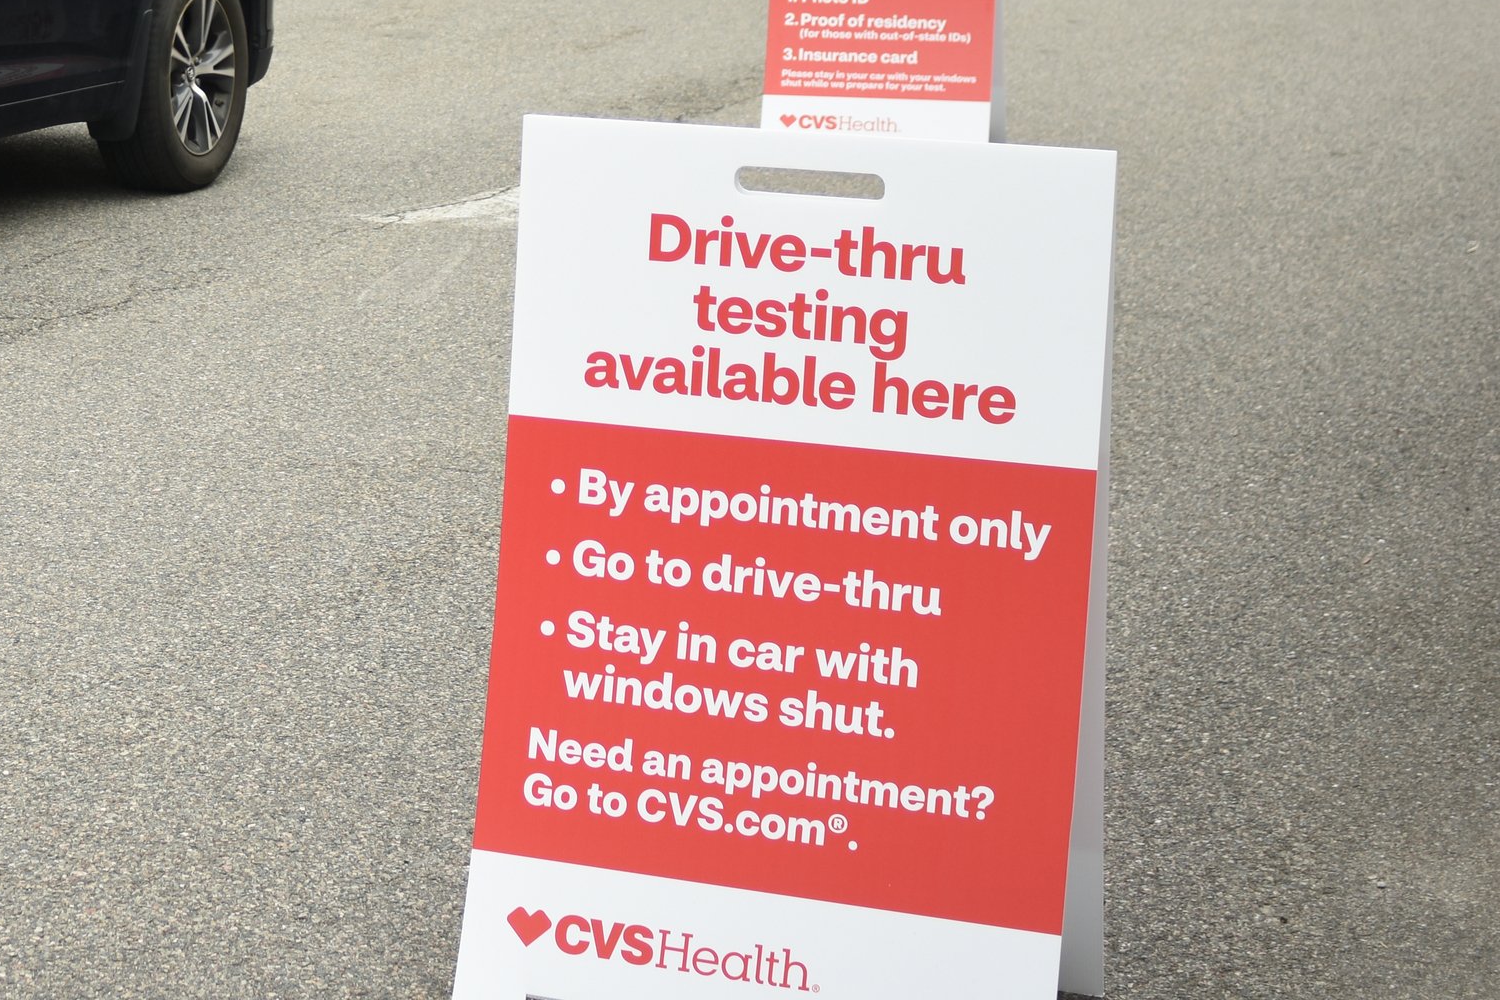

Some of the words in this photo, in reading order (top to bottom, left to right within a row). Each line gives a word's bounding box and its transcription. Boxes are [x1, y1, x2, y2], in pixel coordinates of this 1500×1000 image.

[798, 47, 877, 63] Insurance
[880, 49, 918, 65] card
[800, 12, 845, 27] Proof
[847, 13, 865, 27] of
[867, 14, 947, 33] residency
[800, 27, 820, 40] (for
[822, 28, 852, 39] those
[854, 29, 878, 40] with
[880, 30, 946, 42] out-of-state
[948, 31, 971, 44] IDs)
[649, 213, 965, 284] Drive-thru
[693, 286, 908, 361] testing
[584, 345, 856, 410] available
[872, 361, 1016, 424] here
[579, 468, 634, 516] By
[644, 484, 939, 541] appointment
[950, 510, 1051, 561] only
[573, 540, 635, 580] Go
[646, 550, 691, 587] to
[702, 554, 941, 616] drive-thru
[567, 610, 666, 664] Stay
[677, 621, 716, 663] in
[728, 639, 804, 673] car
[816, 643, 918, 688] with
[564, 664, 768, 722] windows
[779, 690, 895, 739] shut.
[524, 773, 578, 810] Go
[587, 783, 627, 817] to
[528, 727, 633, 772] Need
[642, 750, 691, 780] an
[698, 758, 994, 822] appointment?
